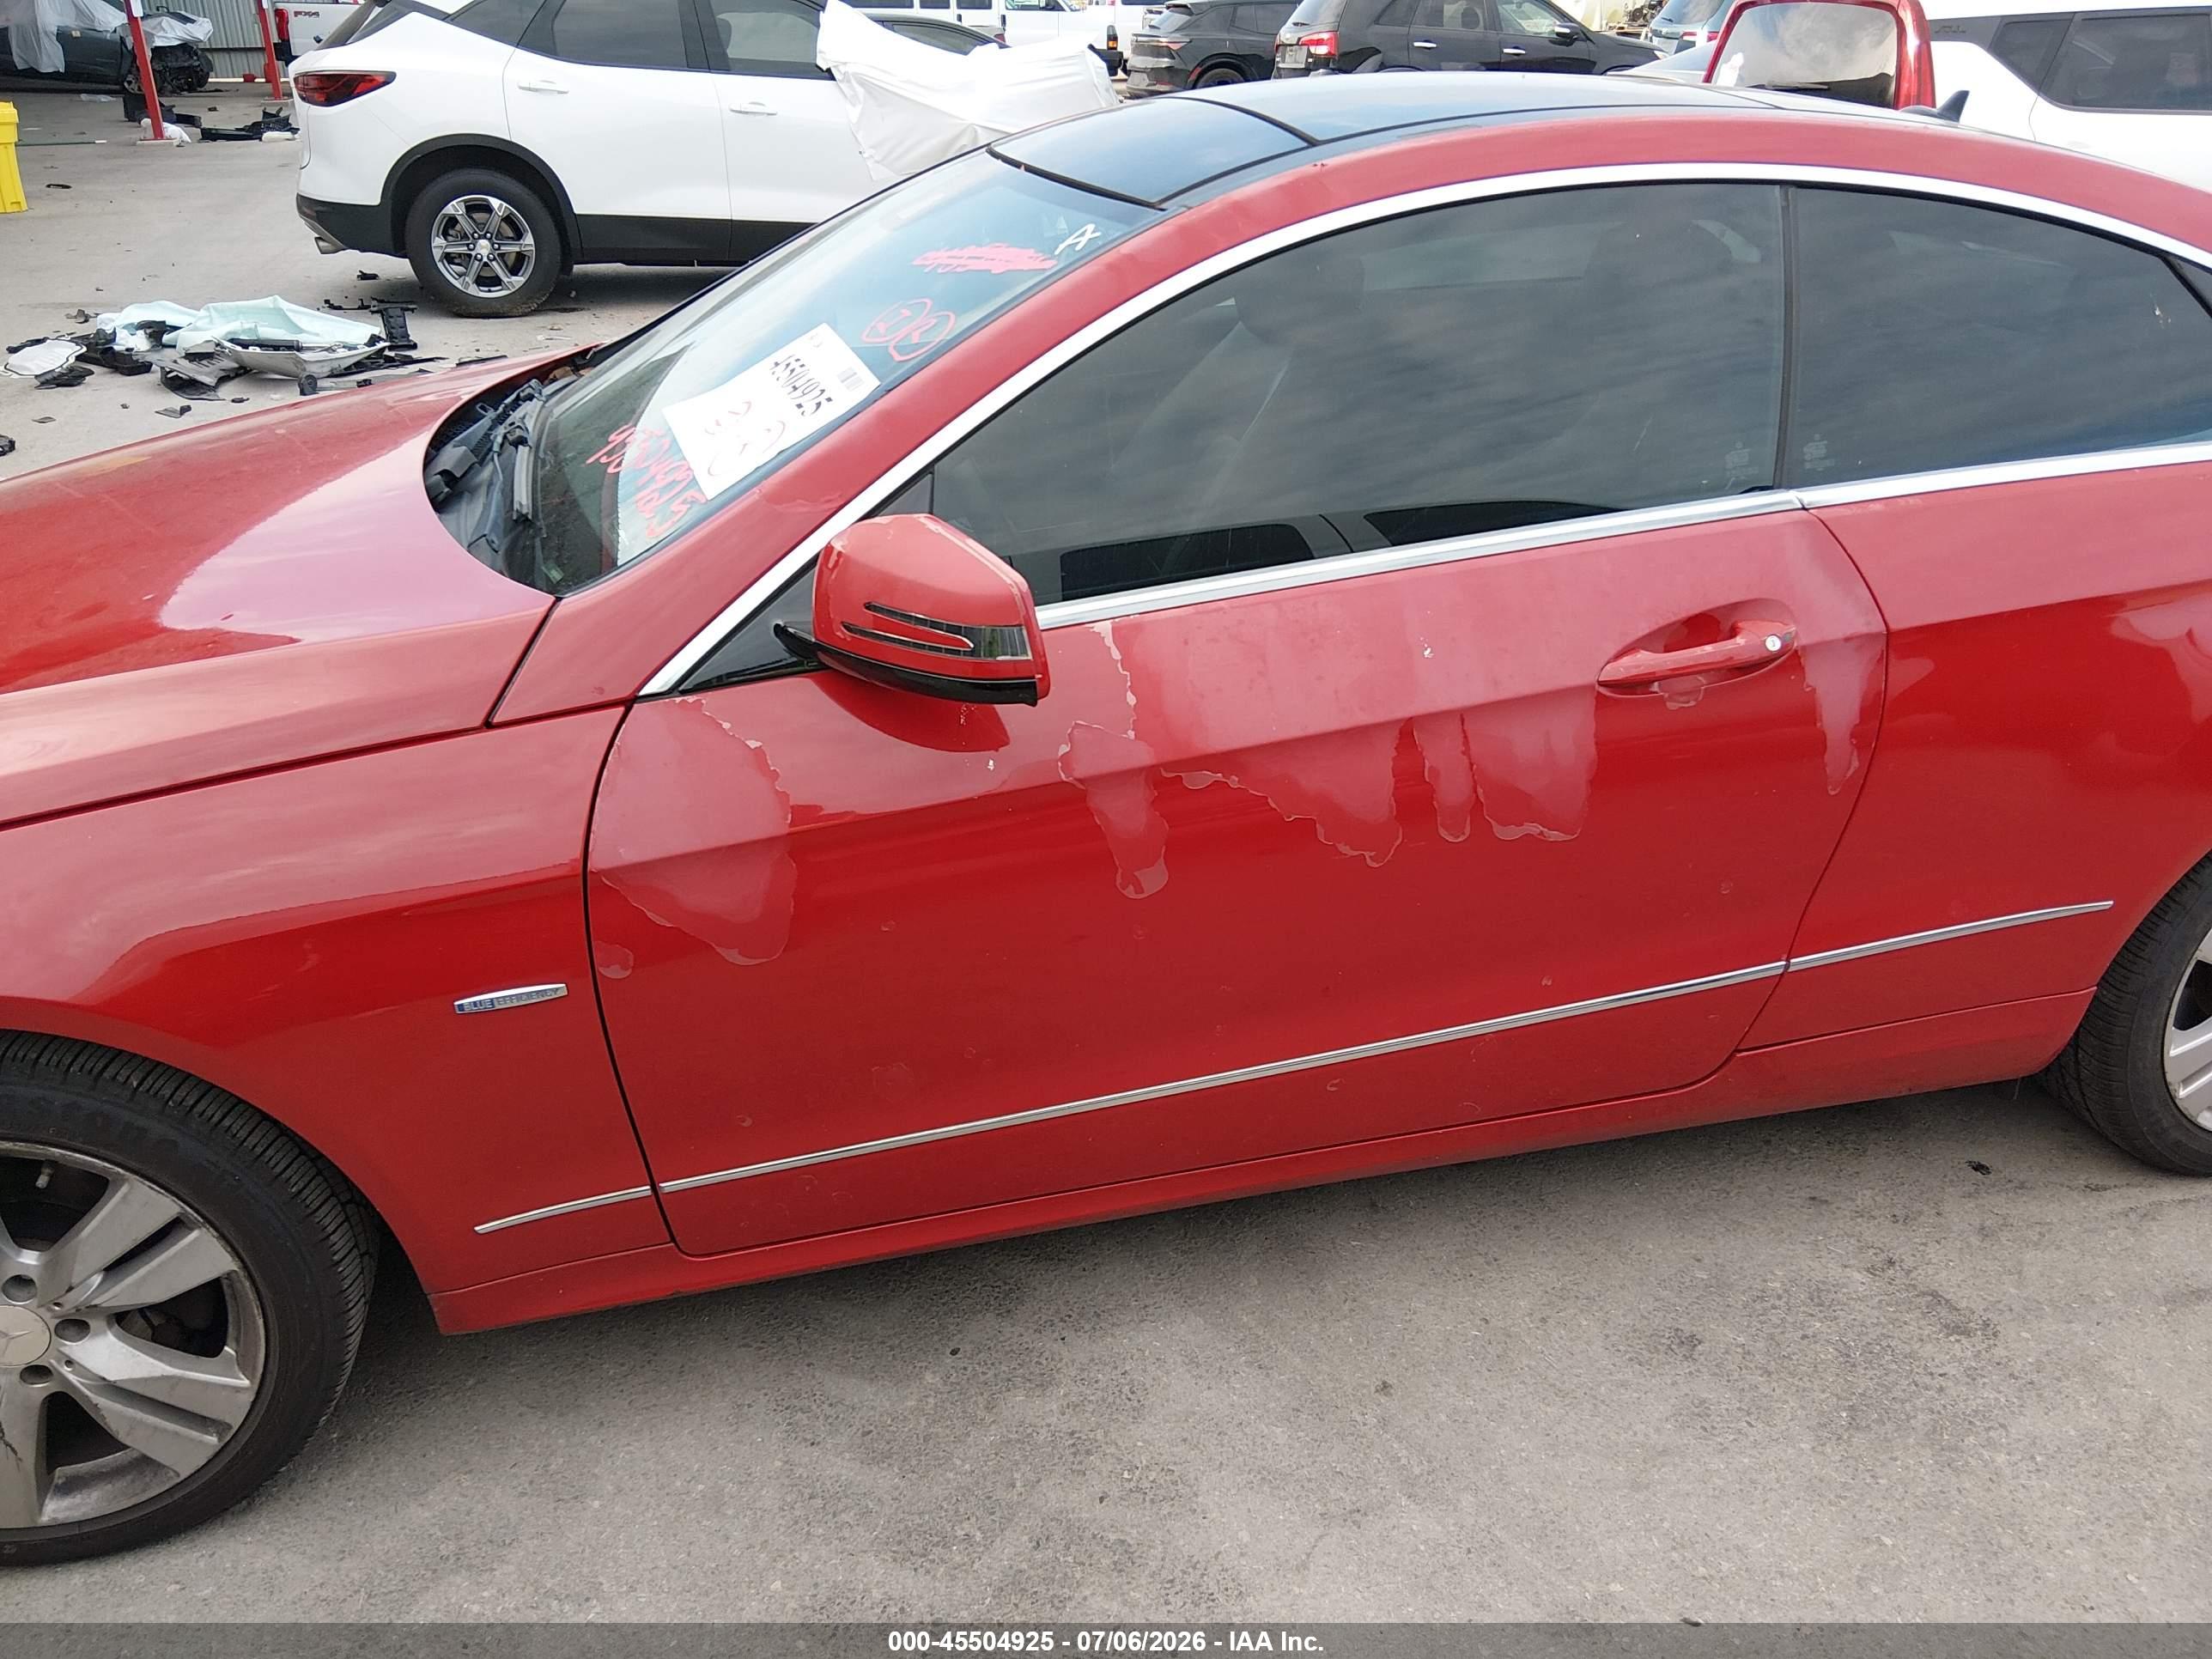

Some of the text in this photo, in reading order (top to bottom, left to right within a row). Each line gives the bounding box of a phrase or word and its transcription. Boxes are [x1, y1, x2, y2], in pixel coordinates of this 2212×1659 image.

[1054, 222, 1102, 256] A
[769, 354, 833, 416] 45504925
[463, 987, 560, 1012] BLUE EFFICIENCY
